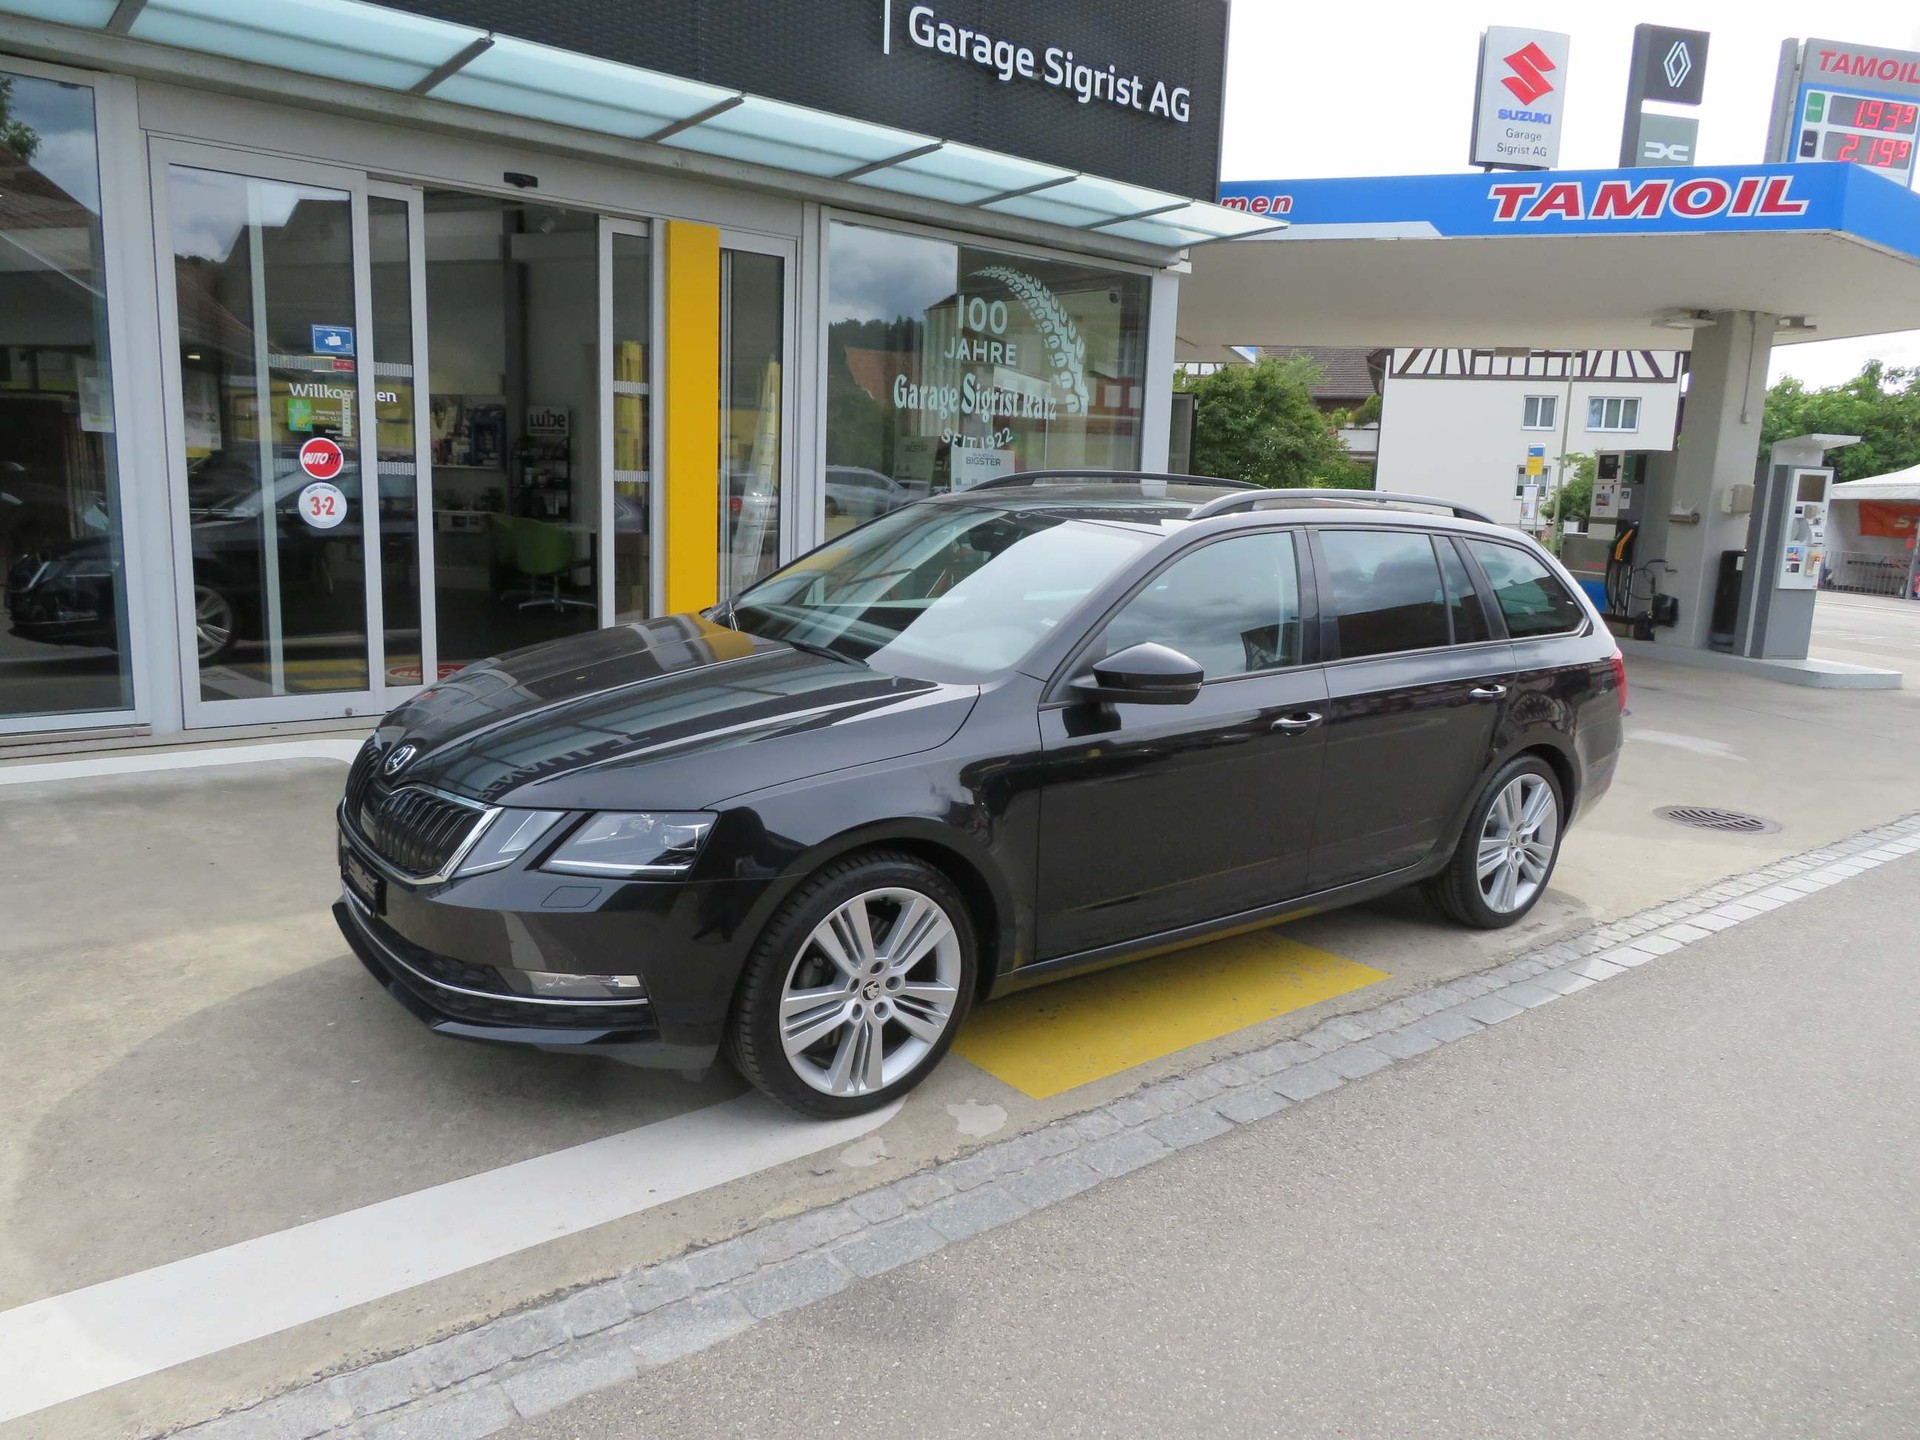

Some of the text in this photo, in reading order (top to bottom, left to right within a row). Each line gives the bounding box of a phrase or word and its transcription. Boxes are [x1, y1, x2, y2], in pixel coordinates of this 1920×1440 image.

[908, 5, 1191, 122] Garage Sigrist AG
[1818, 50, 1920, 84] TAMOIL
[1497, 108, 1552, 125] SUZUKI
[1505, 127, 1542, 142] Garage
[1496, 142, 1547, 157] Sigrist AG
[1487, 175, 1810, 222] TAMOIL
[956, 293, 1009, 335] 100
[944, 336, 1017, 367] JAHRE
[893, 373, 959, 420] Garage
[960, 372, 1019, 423] Sigrist
[940, 426, 1014, 450] SEIT 1922
[303, 452, 342, 465] AUTOFIT
[966, 456, 1001, 467] BIGSTER
